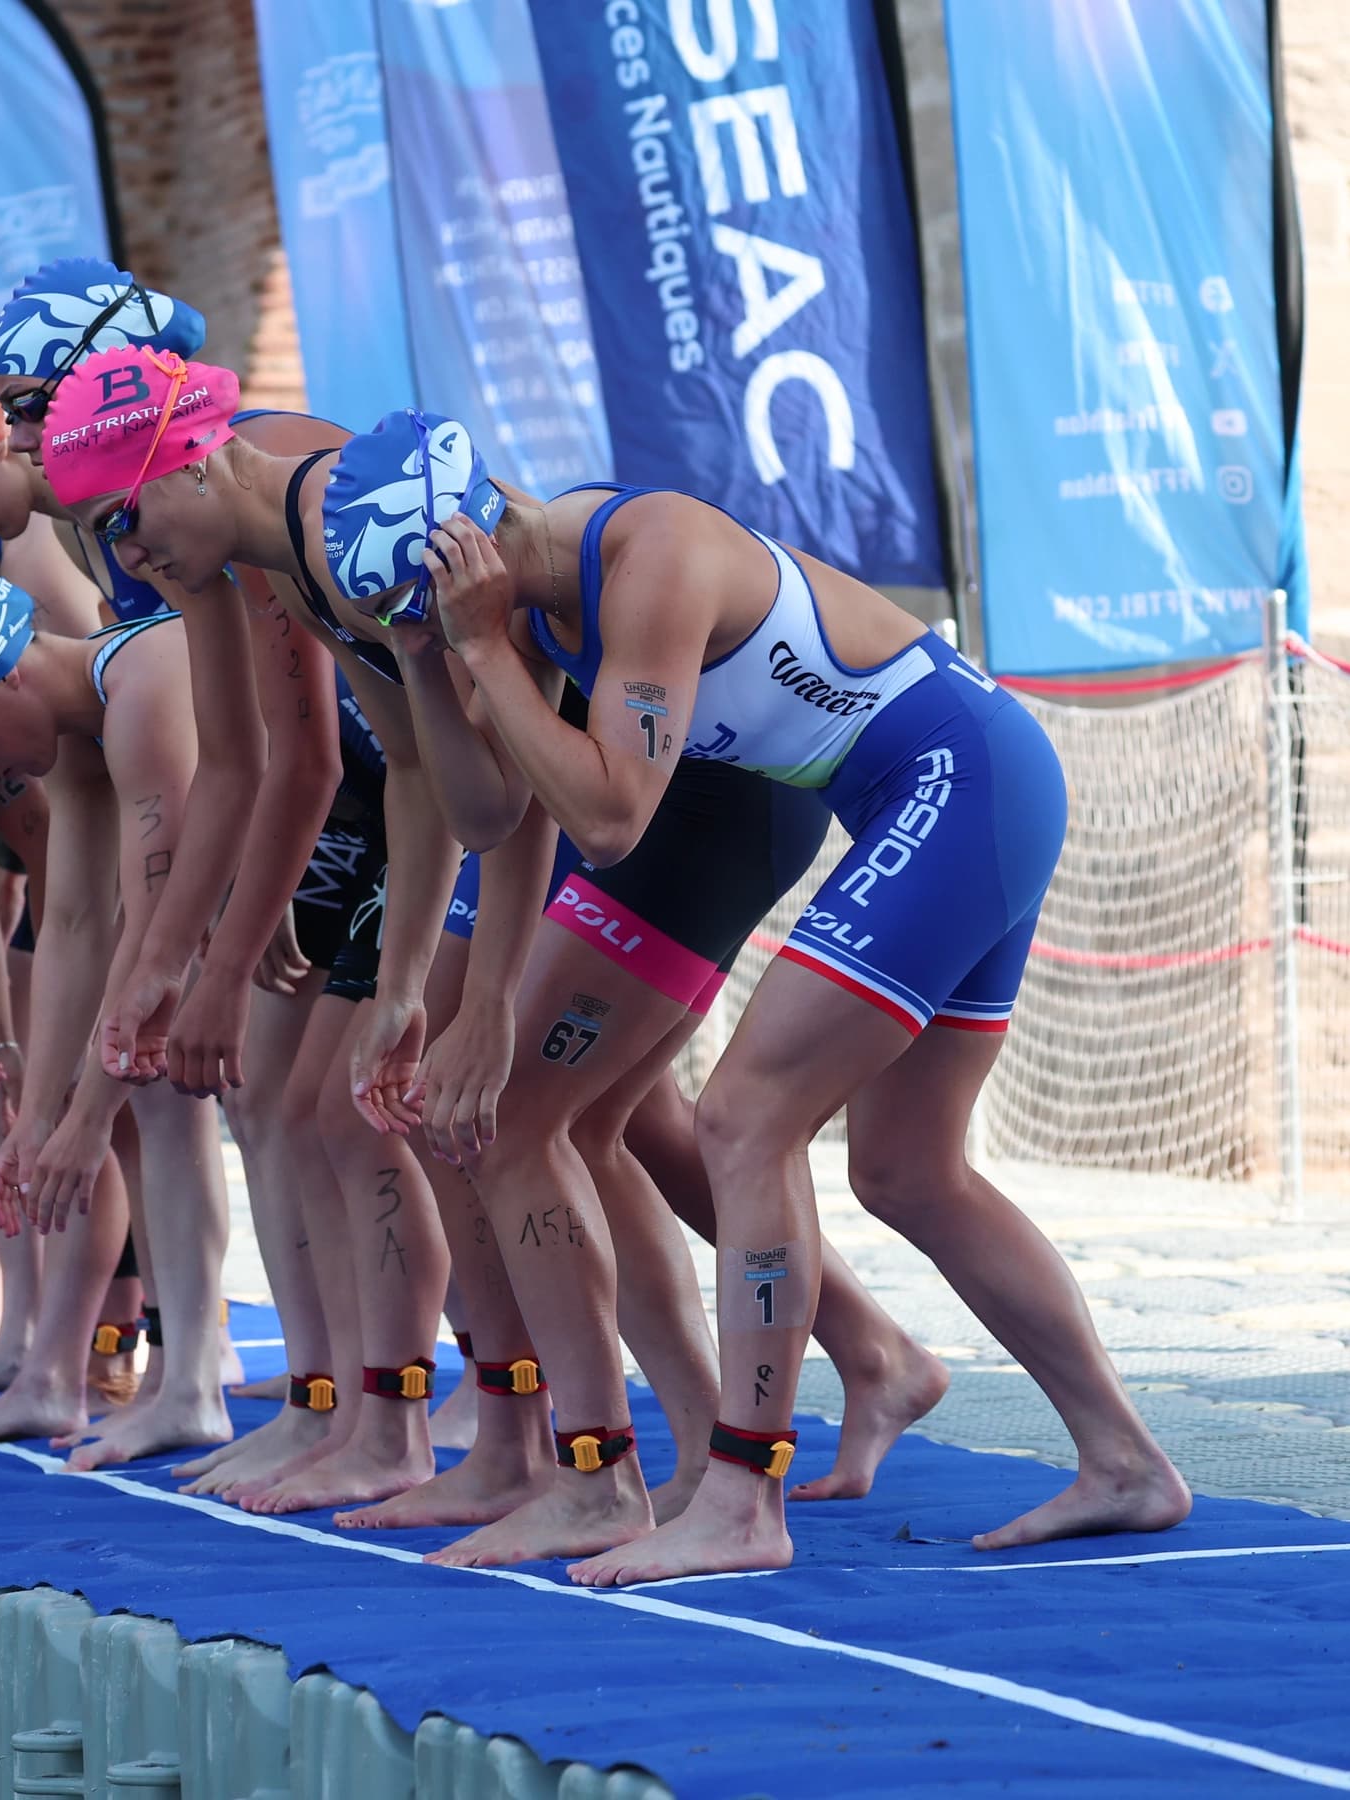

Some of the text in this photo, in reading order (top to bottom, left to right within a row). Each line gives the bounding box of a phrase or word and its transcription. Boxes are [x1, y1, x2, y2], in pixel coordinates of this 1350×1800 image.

[625, 95, 703, 373] Nautiques
[667, 0, 856, 487] SEAC
[52, 433, 100, 458] SAINT
[122, 397, 214, 438] NAAIRE
[52, 425, 91, 446] BEST
[638, 711, 657, 761] 1
[839, 748, 954, 908] POISSY
[555, 886, 643, 953] POLI
[802, 904, 874, 952] POLI
[541, 1019, 601, 1067] 67
[746, 1248, 786, 1265] LINDAHL
[755, 1281, 774, 1326] 1
